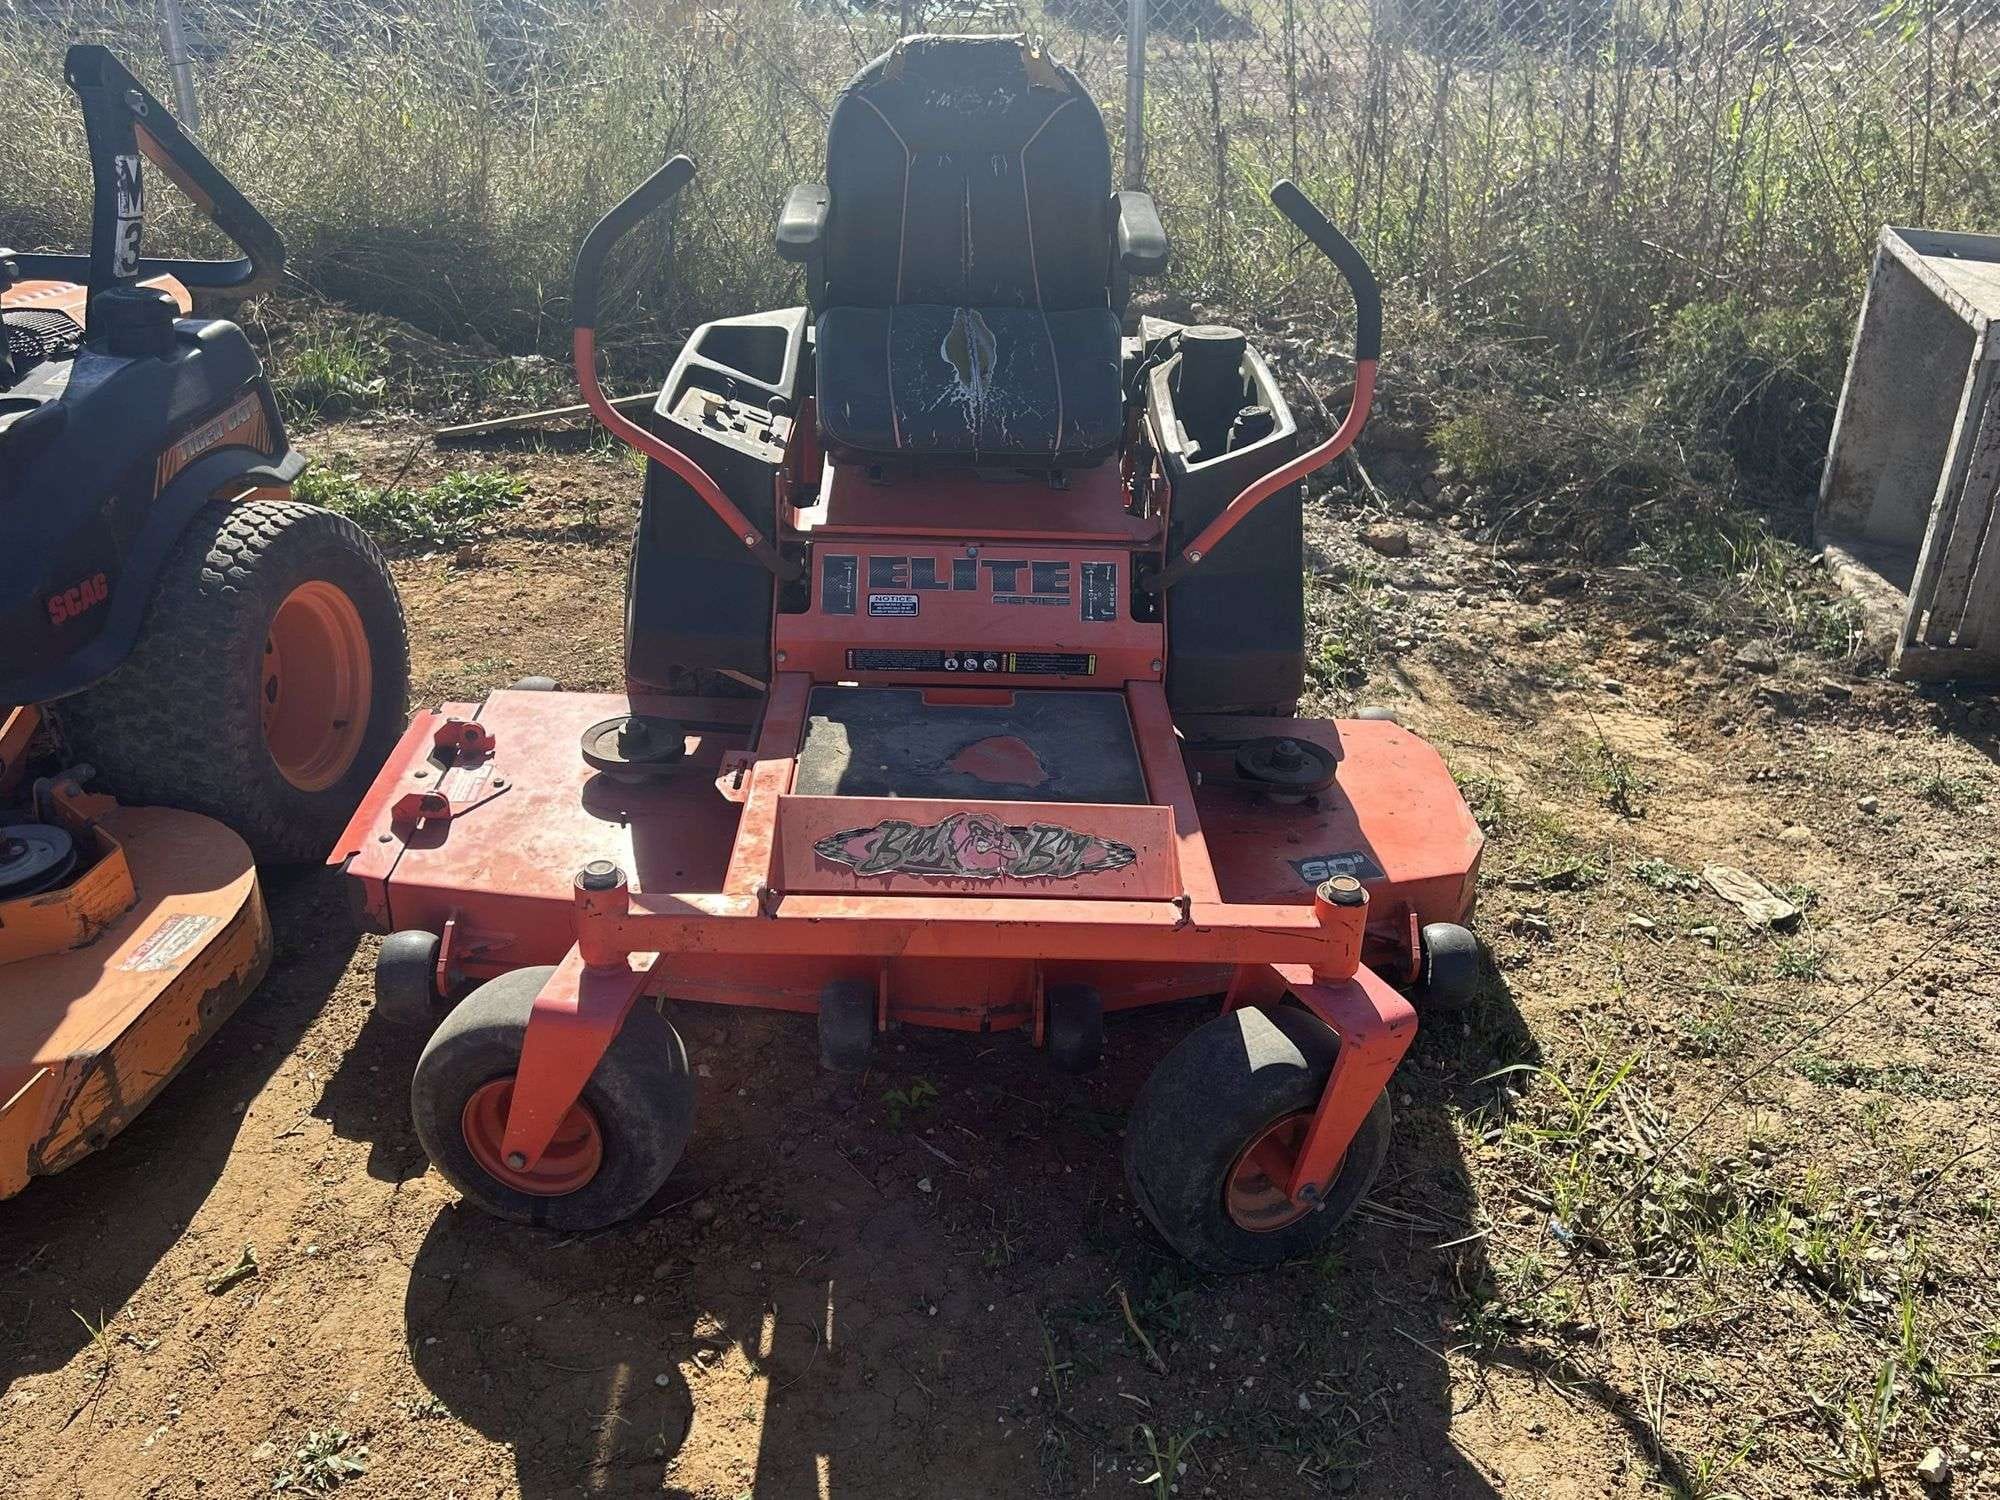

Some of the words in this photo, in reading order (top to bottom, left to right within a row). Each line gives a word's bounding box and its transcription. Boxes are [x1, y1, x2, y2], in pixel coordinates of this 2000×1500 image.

[121, 222, 142, 272] 3
[48, 572, 108, 625] SCAG
[868, 554, 1071, 593] ELITE
[862, 821, 943, 870] Bad
[1015, 824, 1095, 873] Boy
